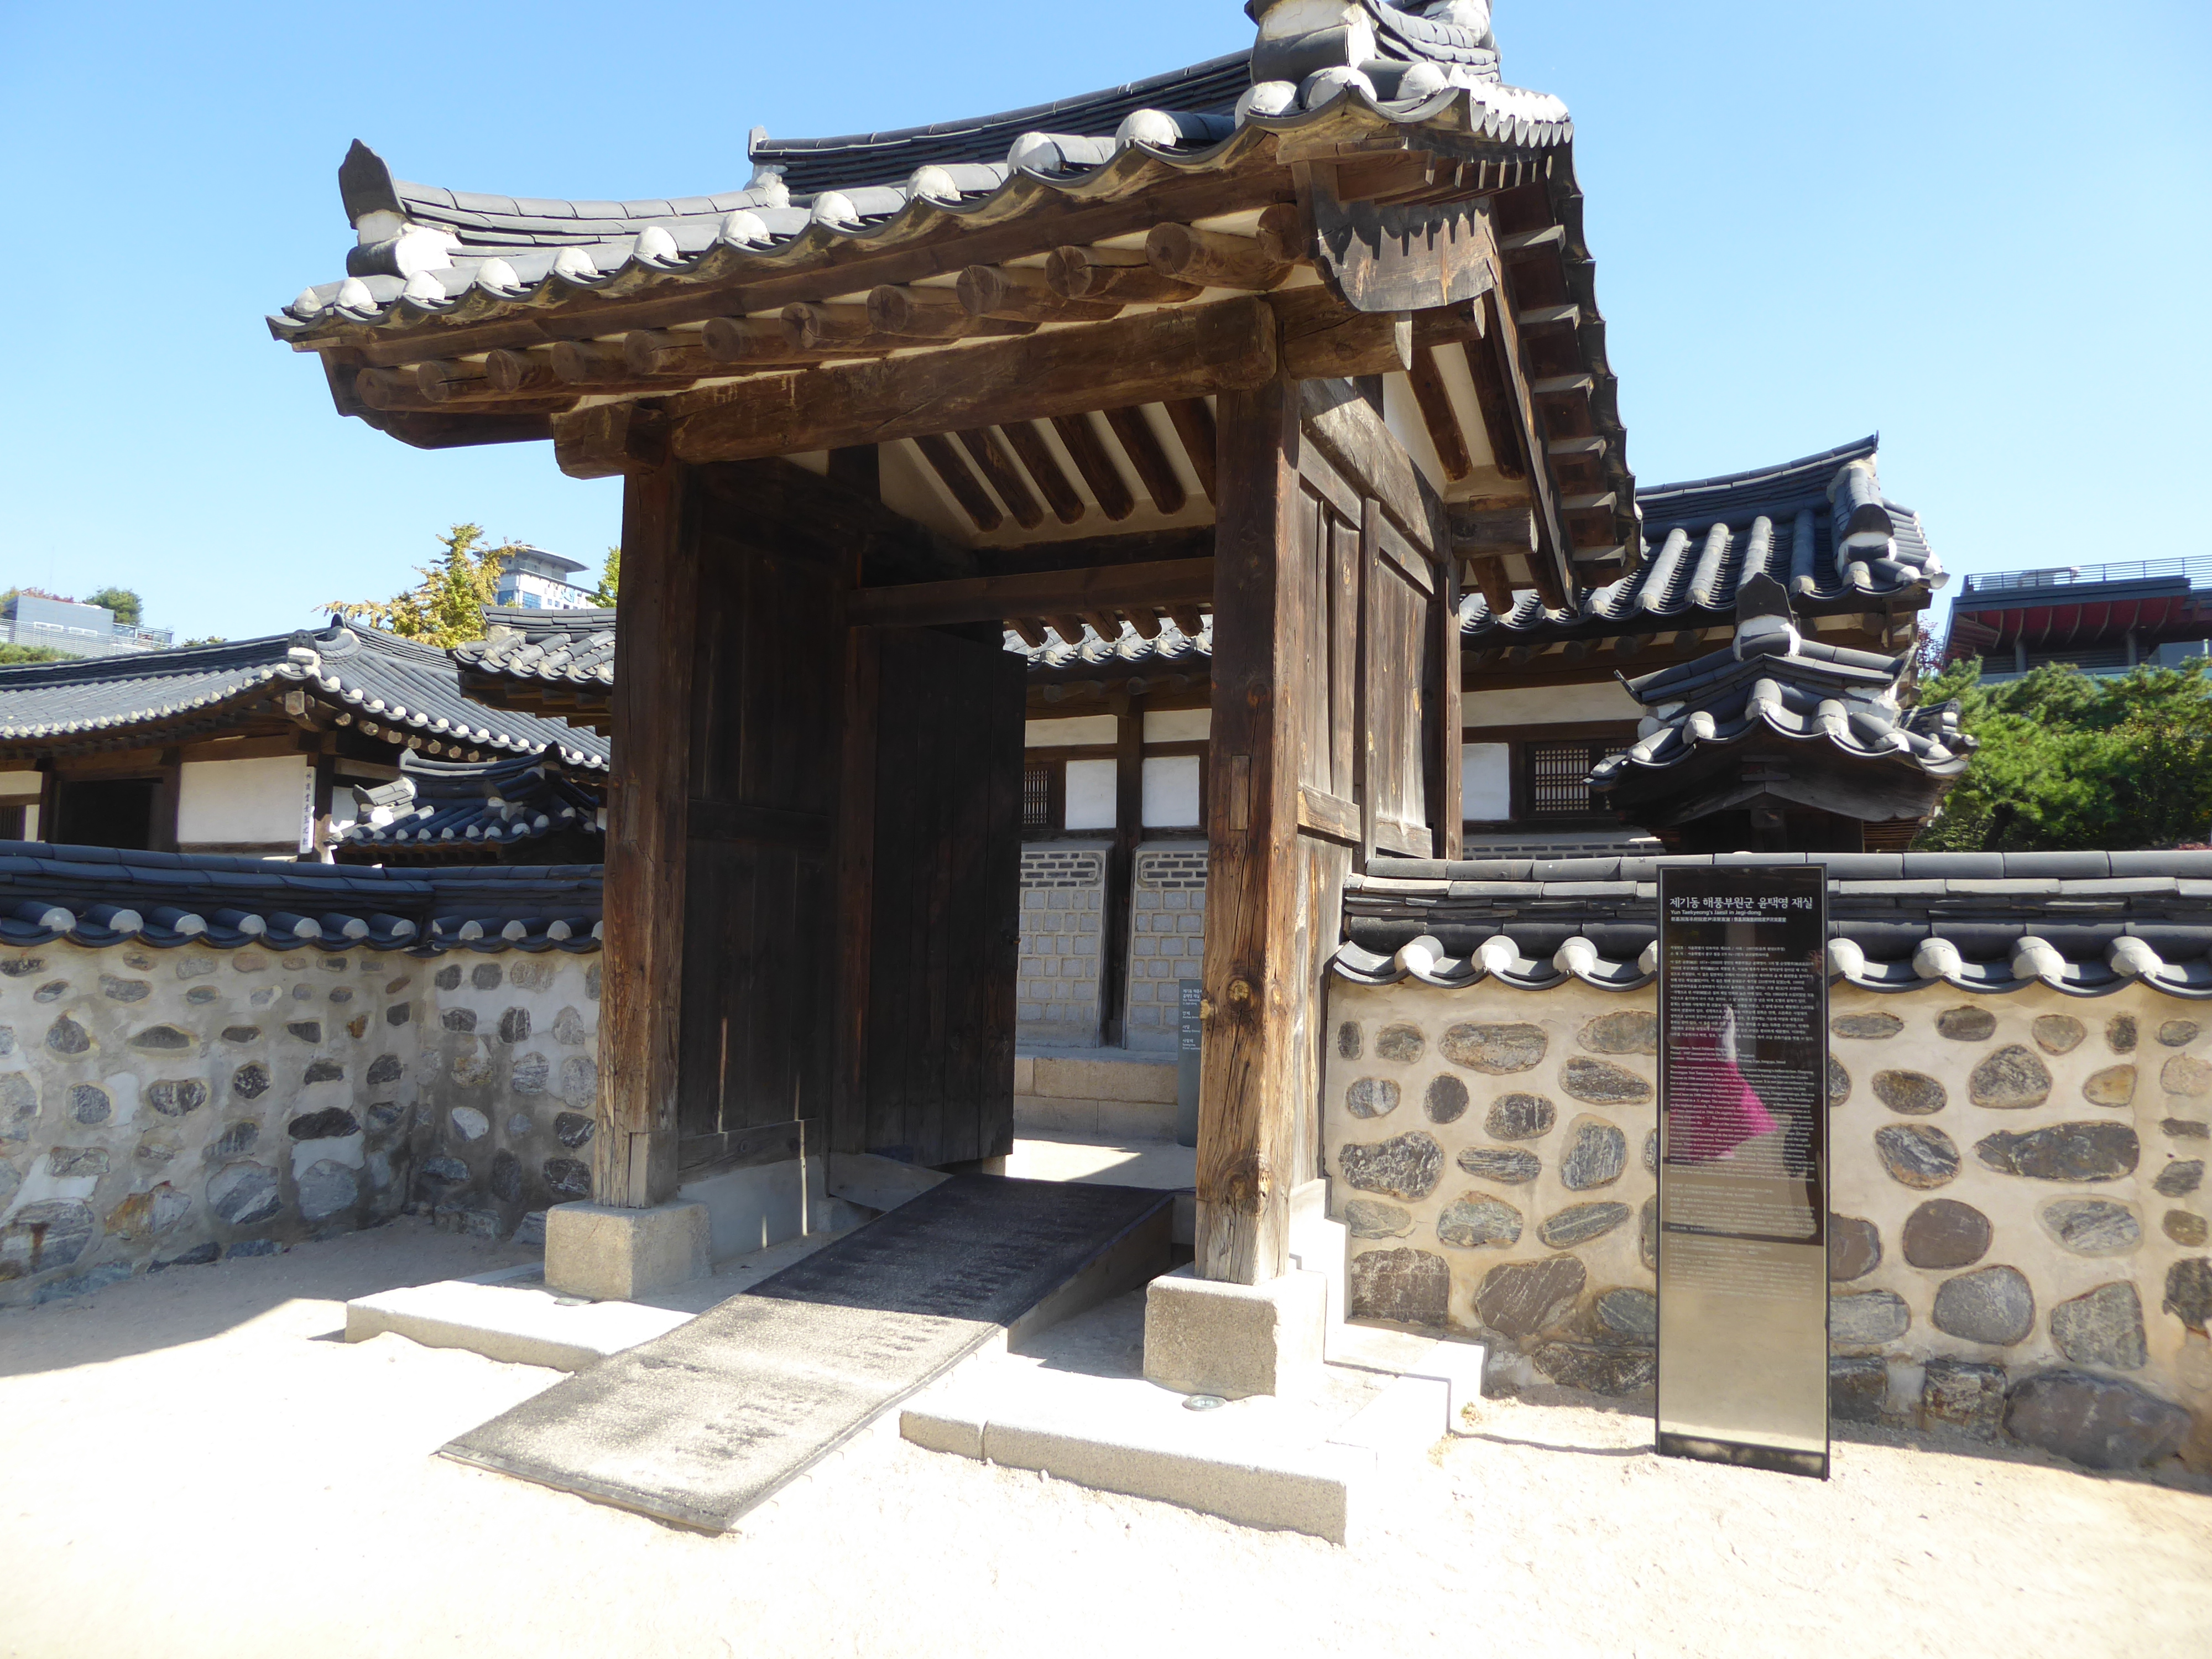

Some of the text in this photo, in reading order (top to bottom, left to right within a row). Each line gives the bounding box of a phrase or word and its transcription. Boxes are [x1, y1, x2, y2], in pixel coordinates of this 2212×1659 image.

[1670, 896, 1813, 909] 제기동 해풍부원군 윤택영 재실
